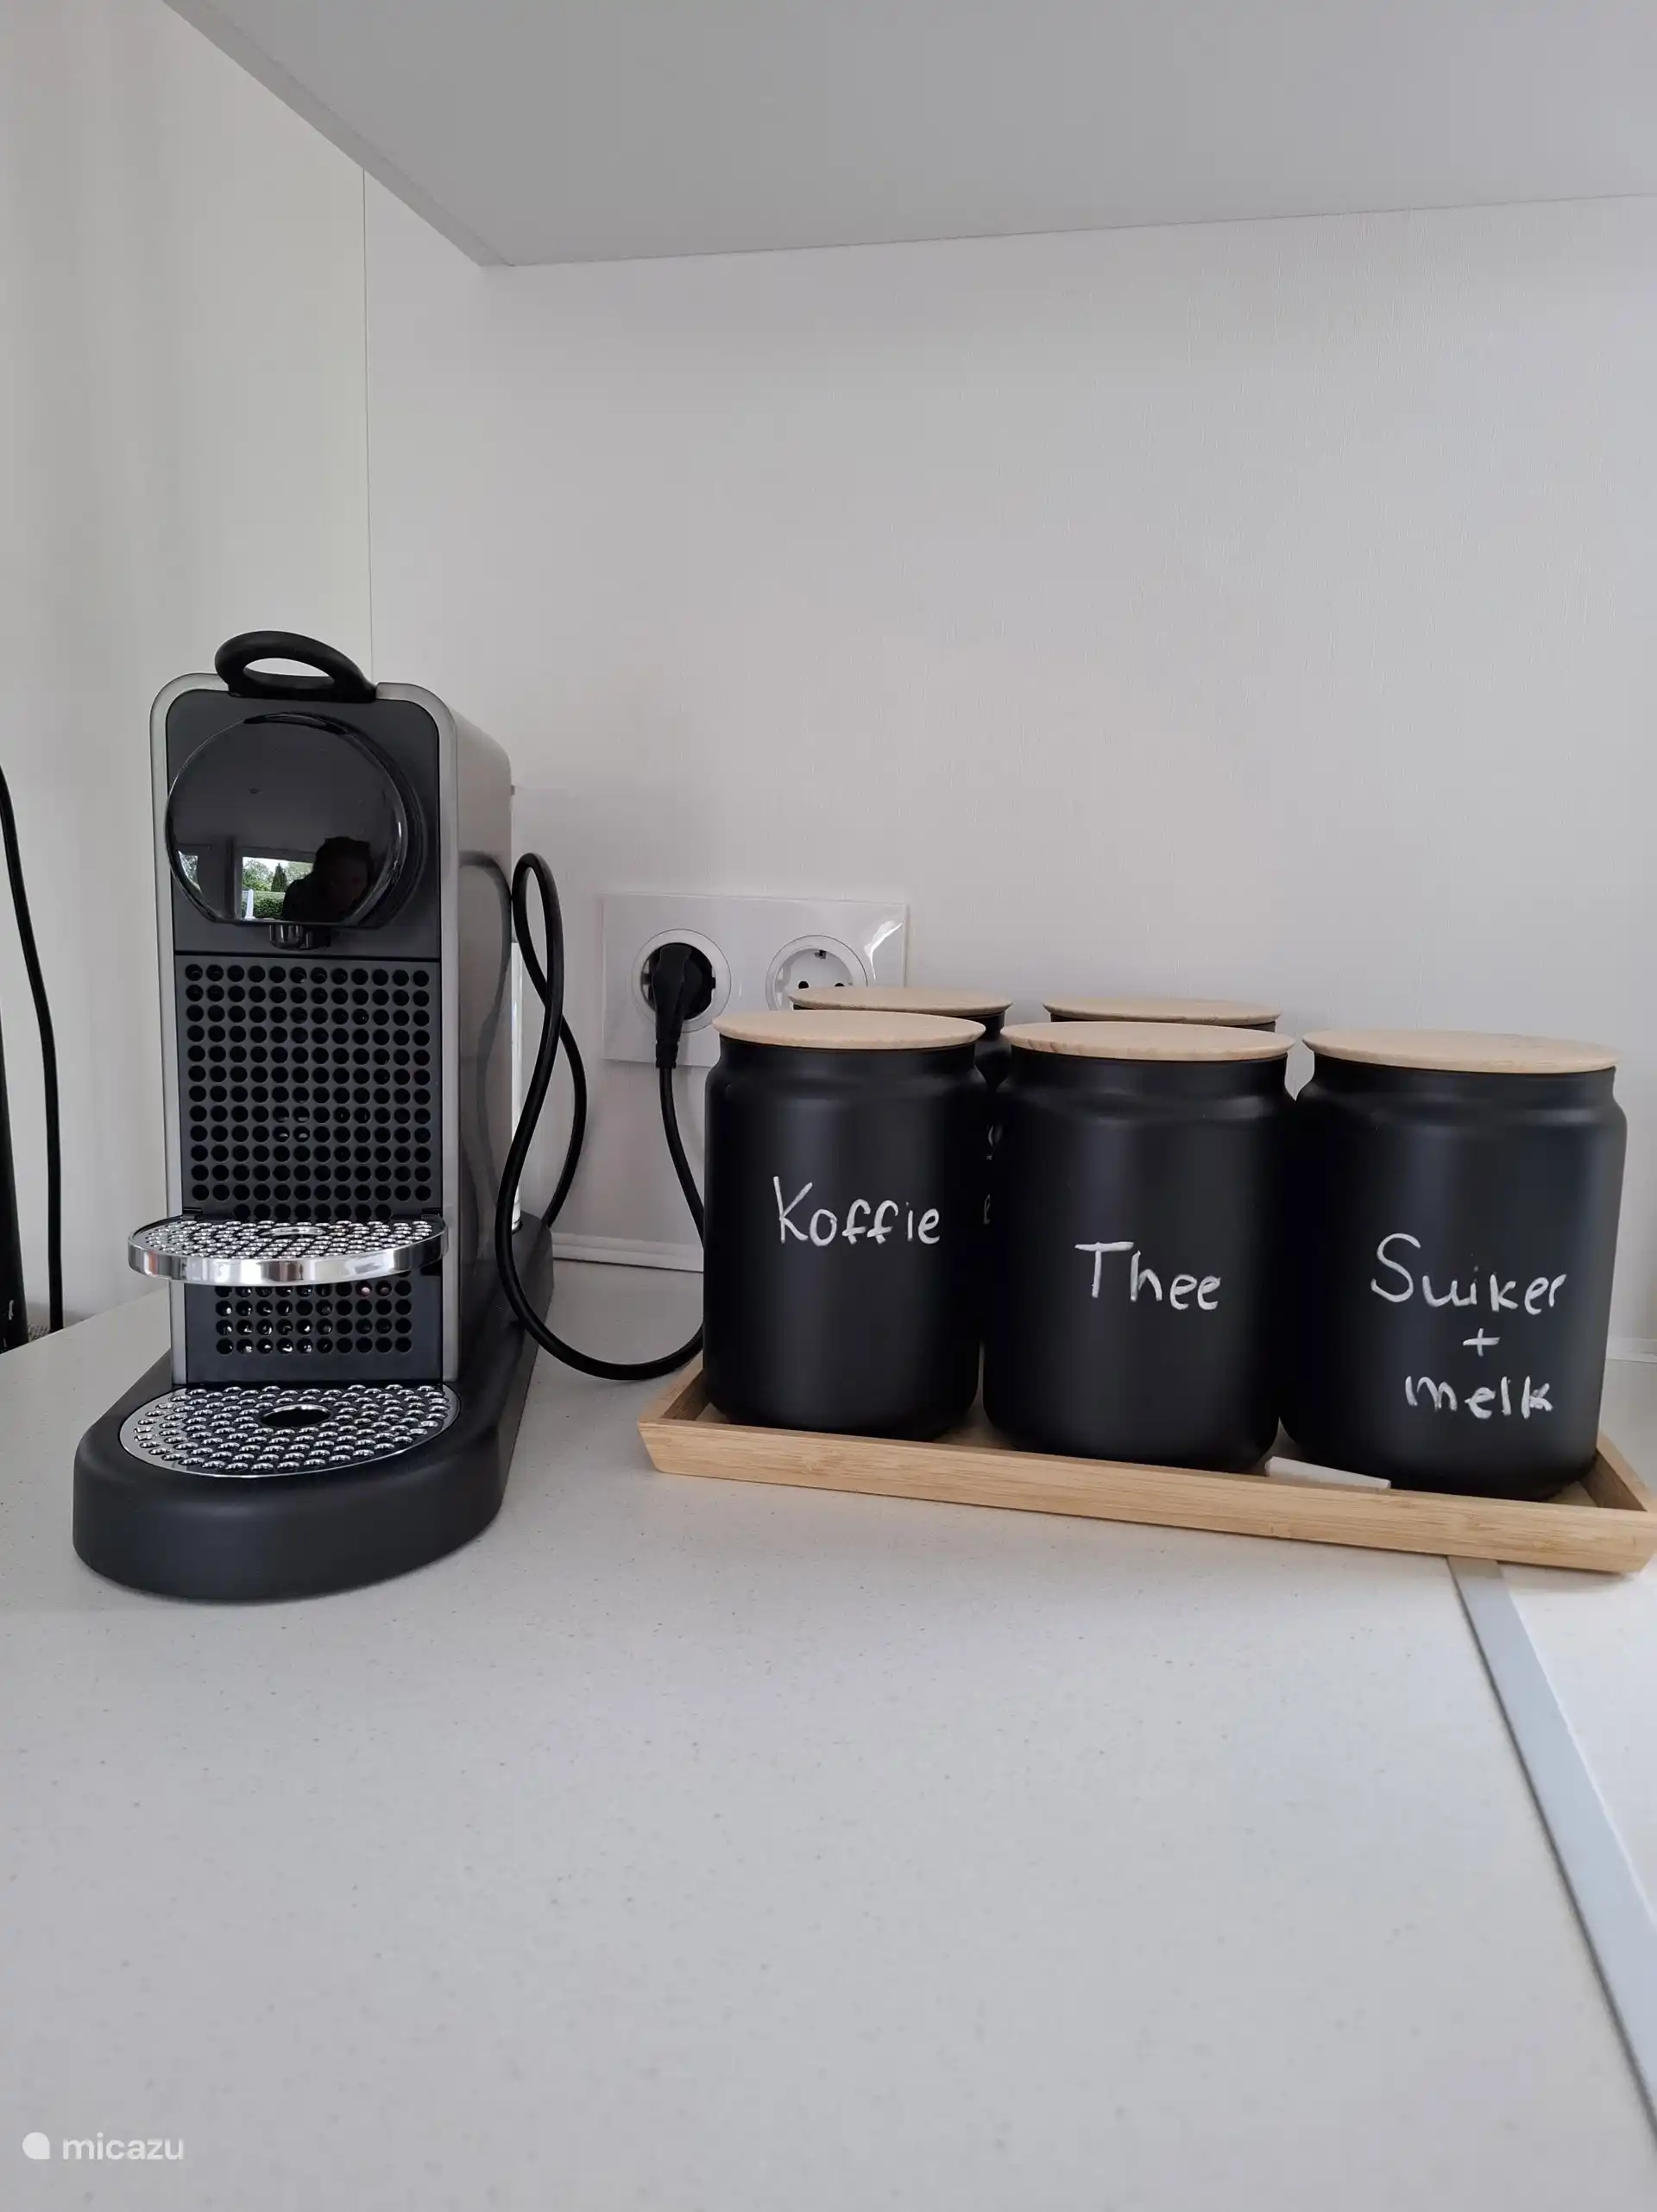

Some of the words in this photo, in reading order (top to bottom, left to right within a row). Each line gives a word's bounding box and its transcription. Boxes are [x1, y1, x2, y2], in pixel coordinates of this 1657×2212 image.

[773, 1175, 940, 1247] Koffie
[1074, 1241, 1221, 1311] Thee
[1370, 1232, 1567, 1315] Suiker
[1462, 1327, 1500, 1357] +
[1405, 1375, 1553, 1419] melk
